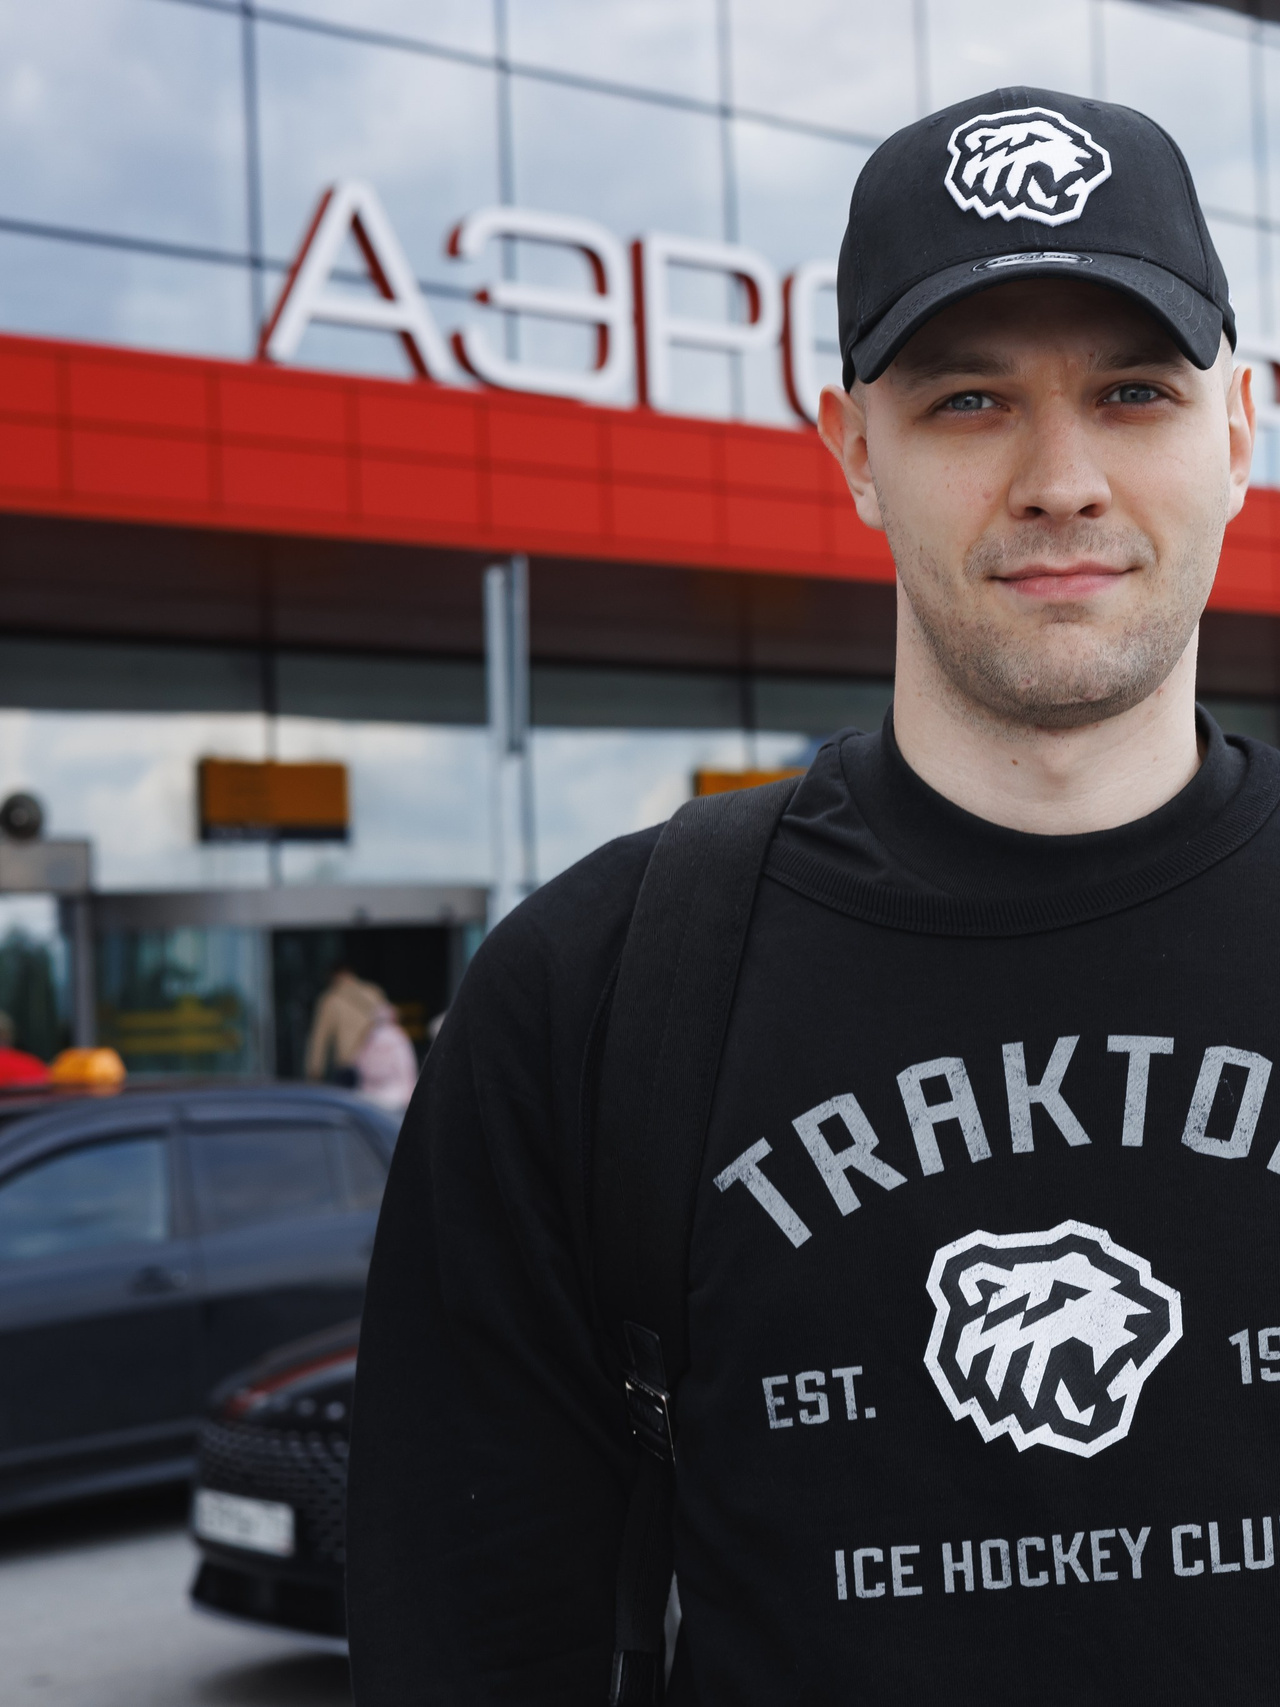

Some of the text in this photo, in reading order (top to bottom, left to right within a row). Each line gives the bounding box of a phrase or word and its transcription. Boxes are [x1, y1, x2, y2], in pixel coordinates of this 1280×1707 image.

[762, 1366, 876, 1429] EST.
[835, 1545, 922, 1601] ICE
[942, 1527, 1152, 1593] HOCKEY
